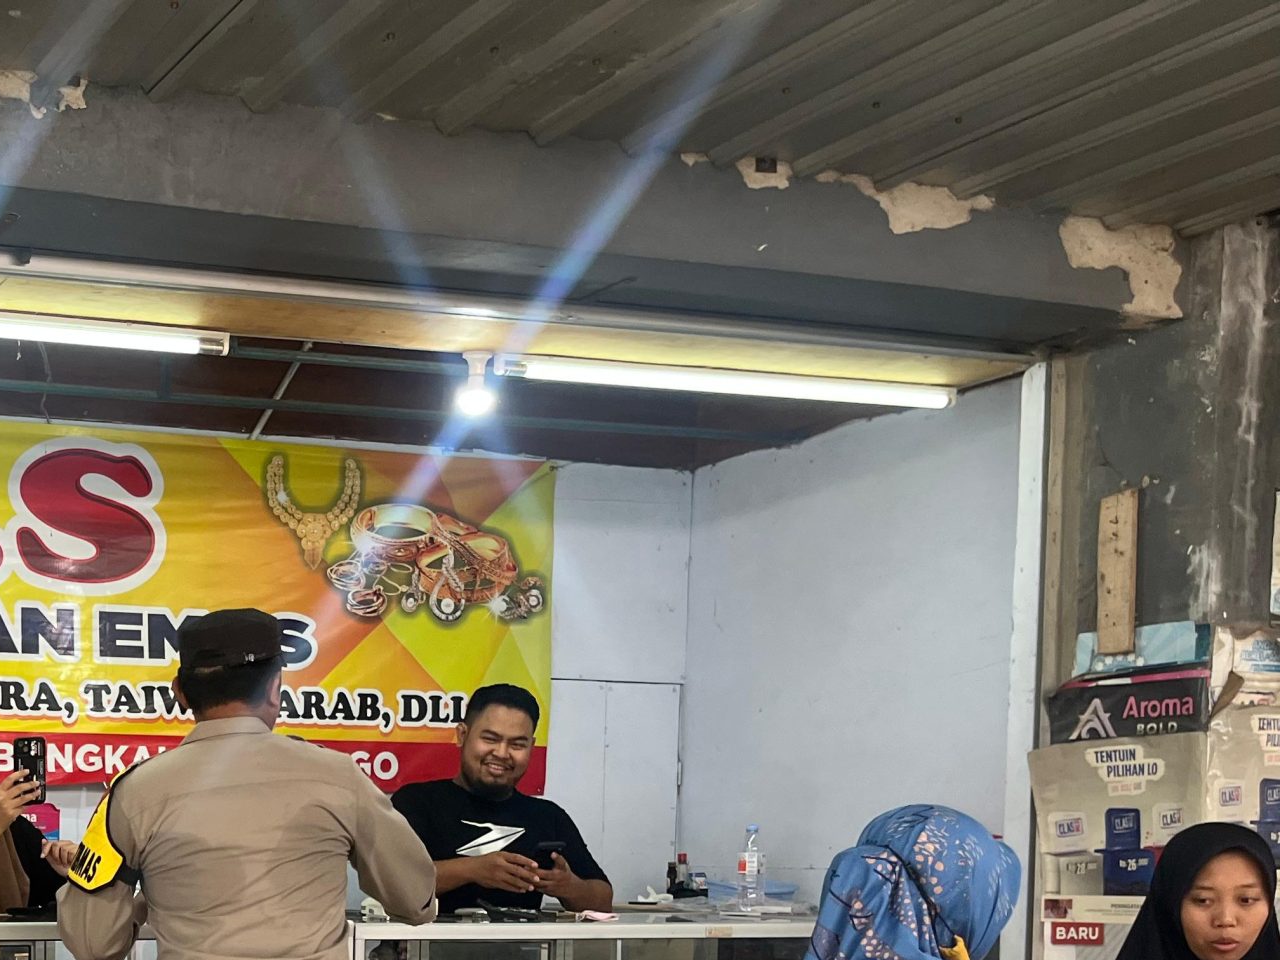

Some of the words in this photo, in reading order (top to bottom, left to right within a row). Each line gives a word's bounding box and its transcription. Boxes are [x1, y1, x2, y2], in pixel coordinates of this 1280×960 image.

[98, 610, 313, 665] EMS
[83, 682, 188, 716] TAIW
[279, 688, 391, 729] ARAB,
[1122, 696, 1195, 720] Aroma
[1136, 722, 1179, 735] BOLD
[1094, 748, 1137, 764] TENTUIN
[1106, 763, 1145, 778] PILIHAN
[1147, 762, 1159, 777] LO
[1055, 926, 1100, 941] BARU
